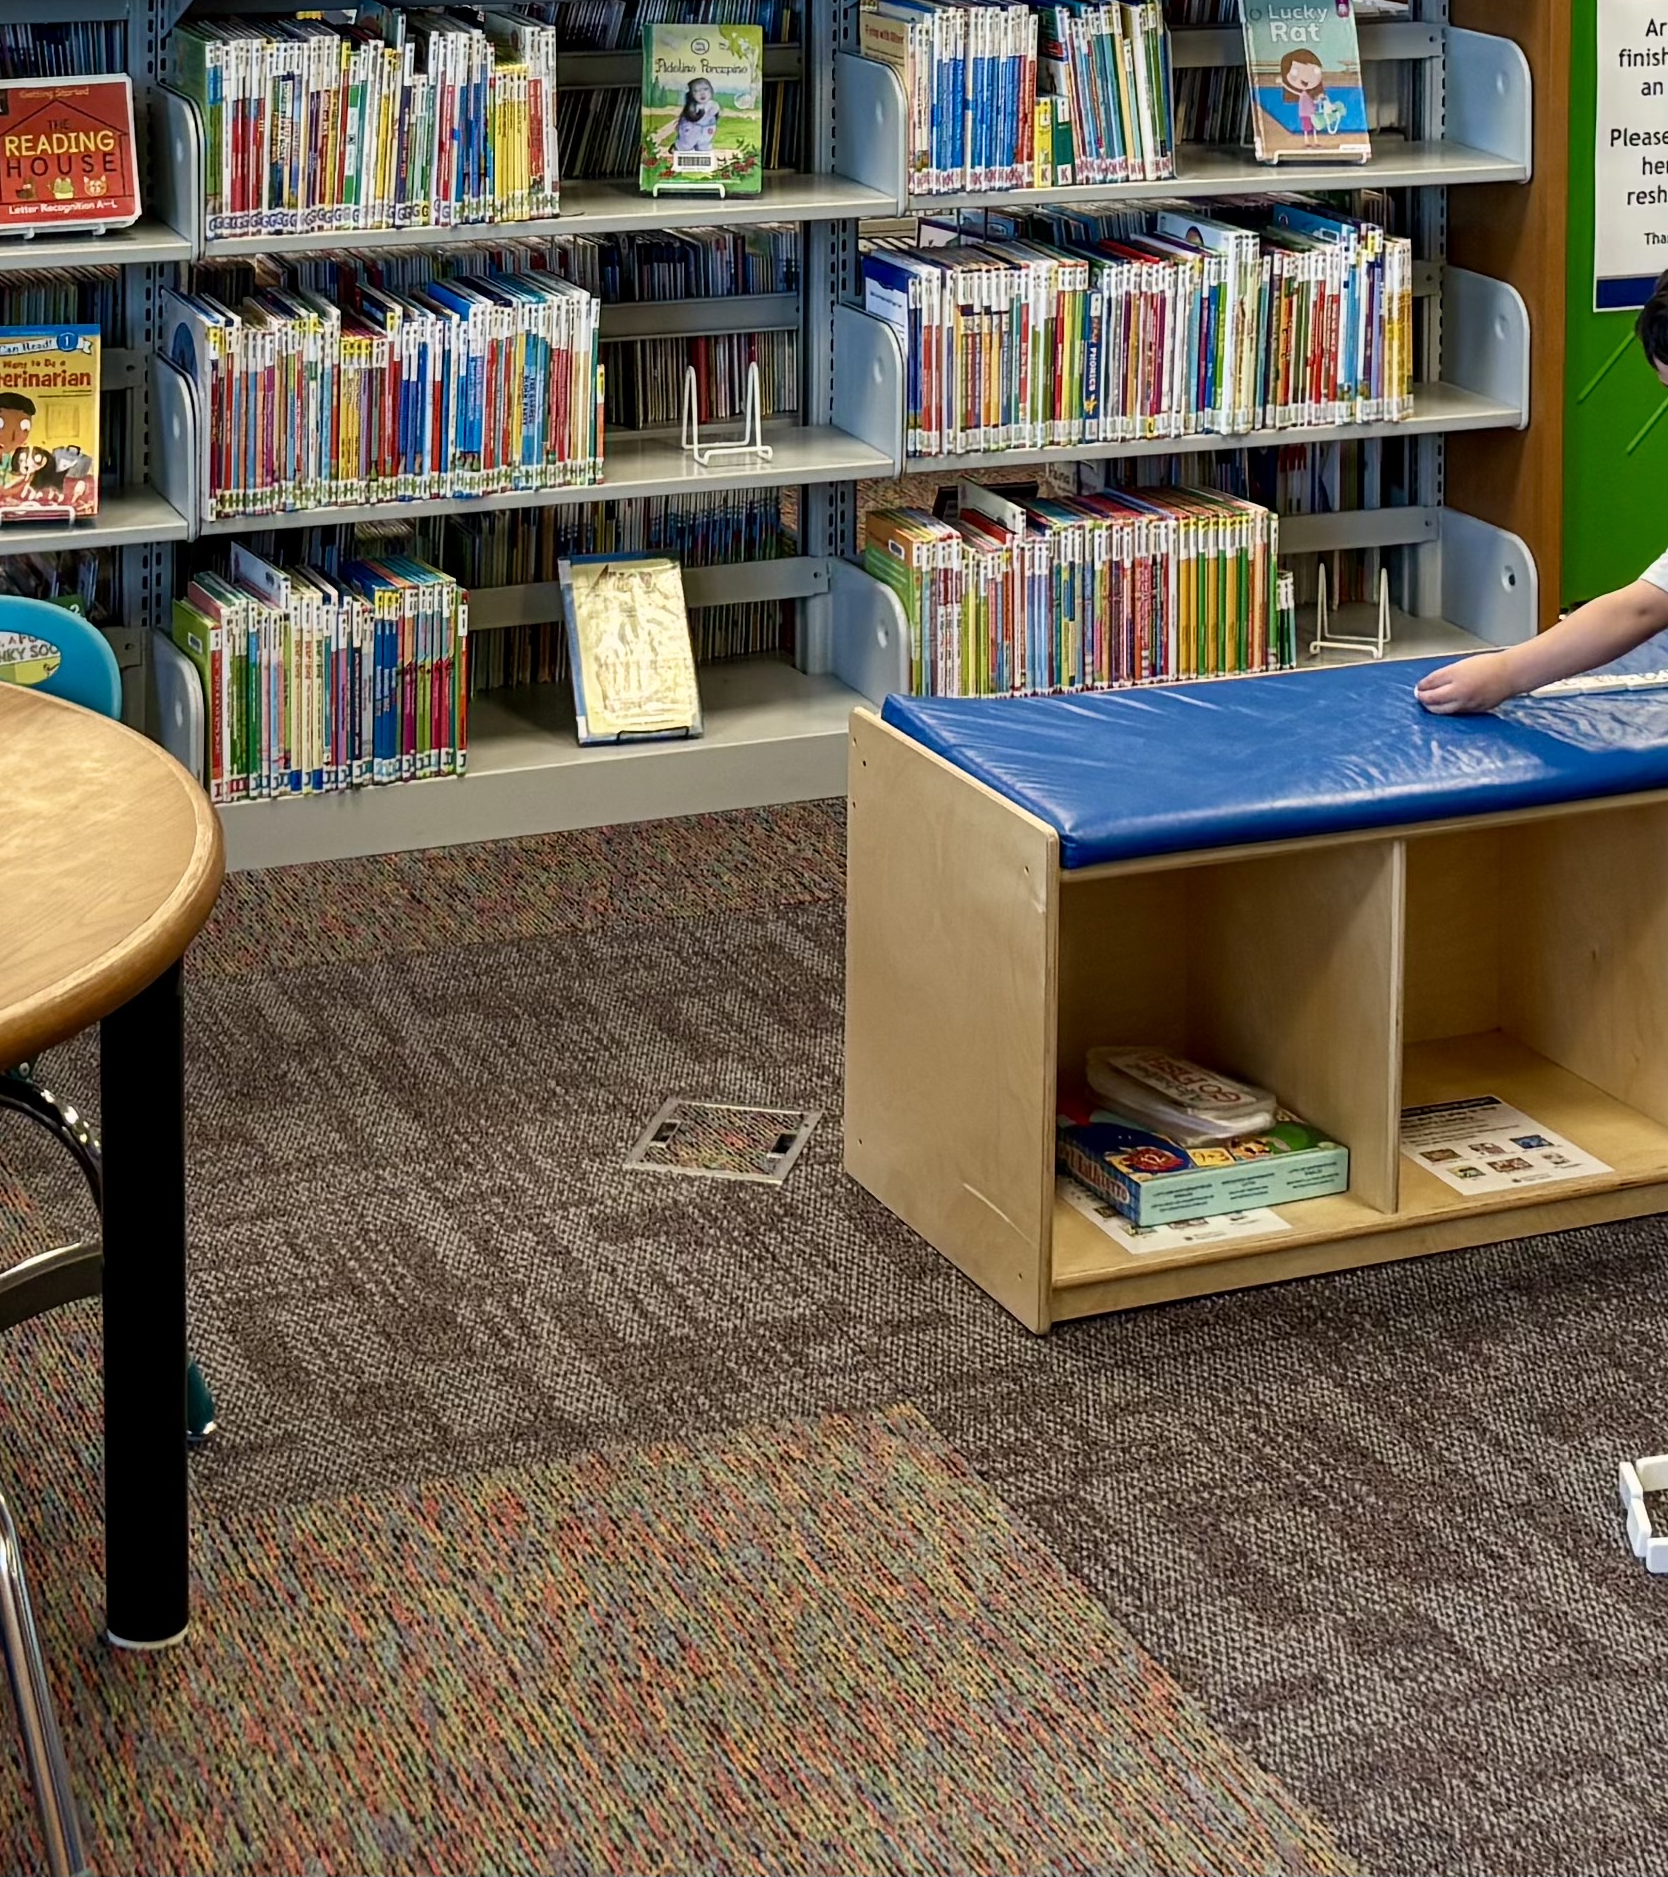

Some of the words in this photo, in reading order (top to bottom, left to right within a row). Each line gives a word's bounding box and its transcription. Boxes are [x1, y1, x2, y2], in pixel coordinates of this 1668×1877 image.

[1268, 4, 1328, 23] Lucky
[1269, 22, 1321, 42] Rat
[1641, 79, 1664, 96] an
[48, 118, 71, 130] THE
[4, 130, 115, 157] READING
[6, 152, 117, 178] HOUSE
[8, 204, 39, 215] Letter
[40, 203, 95, 214] Recognition
[22, 339, 52, 351] Read!
